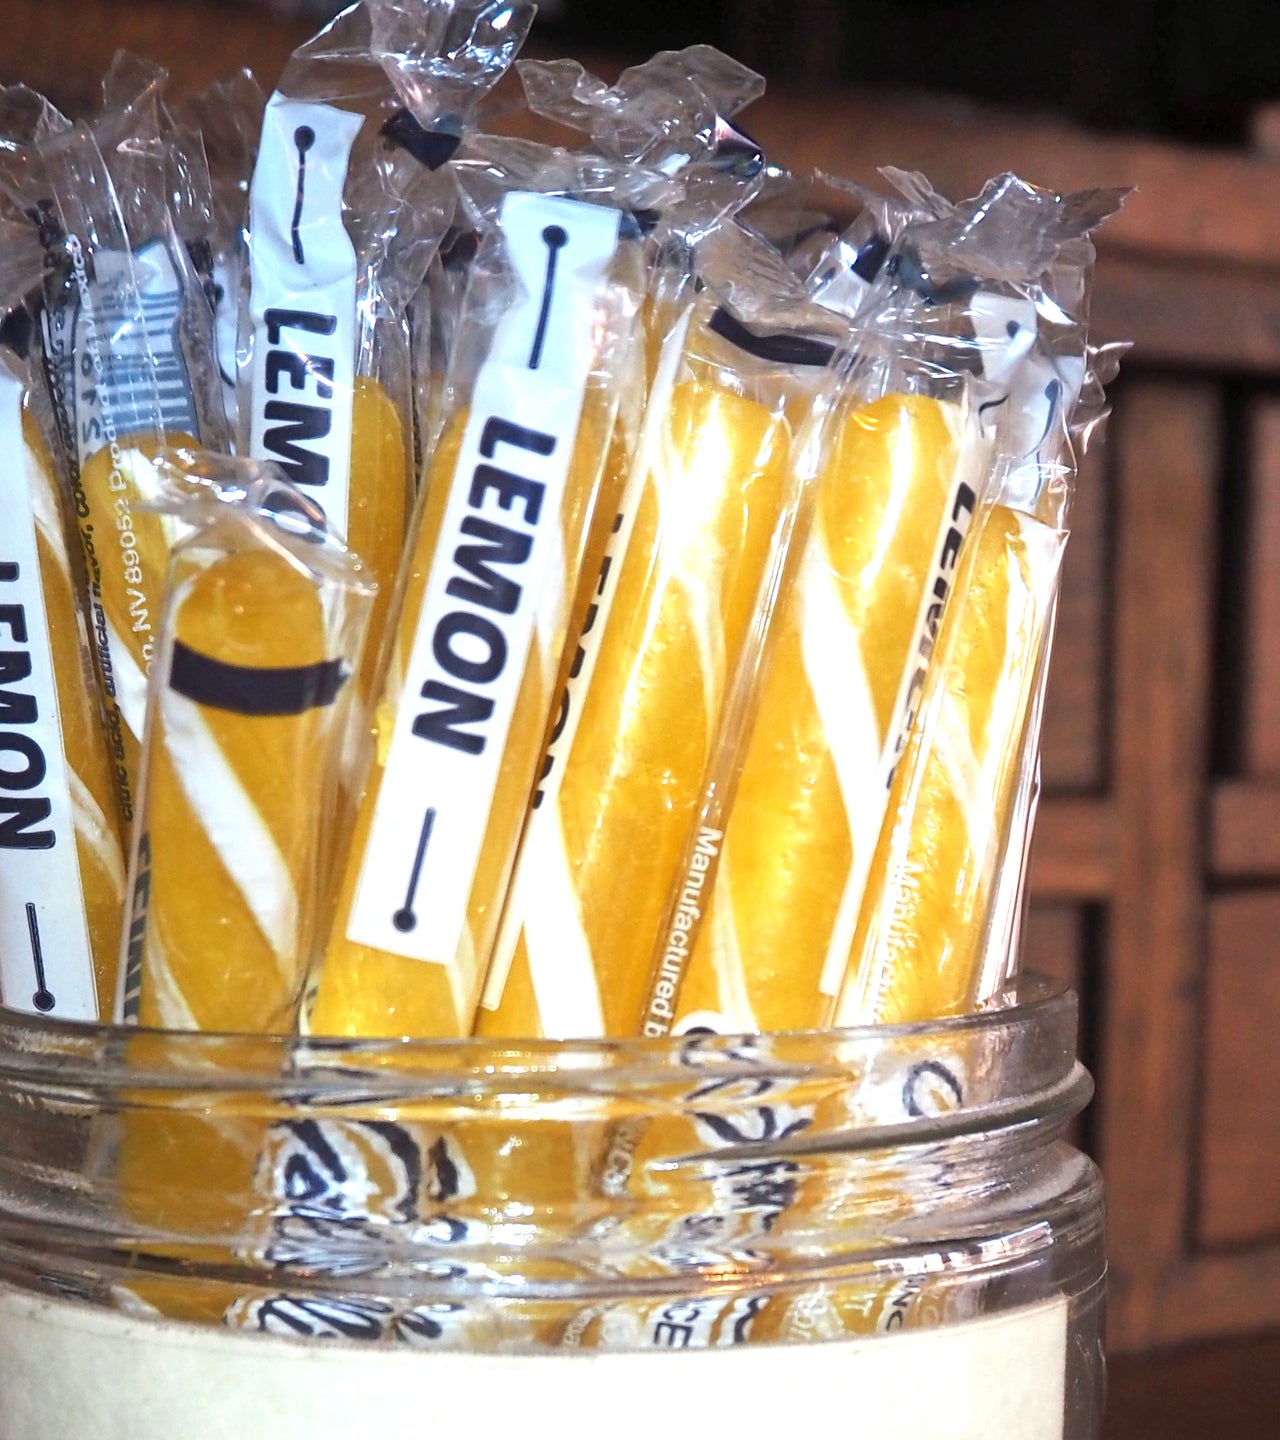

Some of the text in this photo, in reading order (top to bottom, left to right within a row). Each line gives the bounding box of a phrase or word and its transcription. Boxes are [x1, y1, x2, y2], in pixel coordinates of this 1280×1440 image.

[263, 307, 337, 545] LEMO
[114, 498, 143, 583] 89052
[411, 415, 559, 756] LEMON
[126, 588, 152, 633] NV
[649, 825, 723, 1019] Manufactured
[643, 1016, 670, 1038] b
